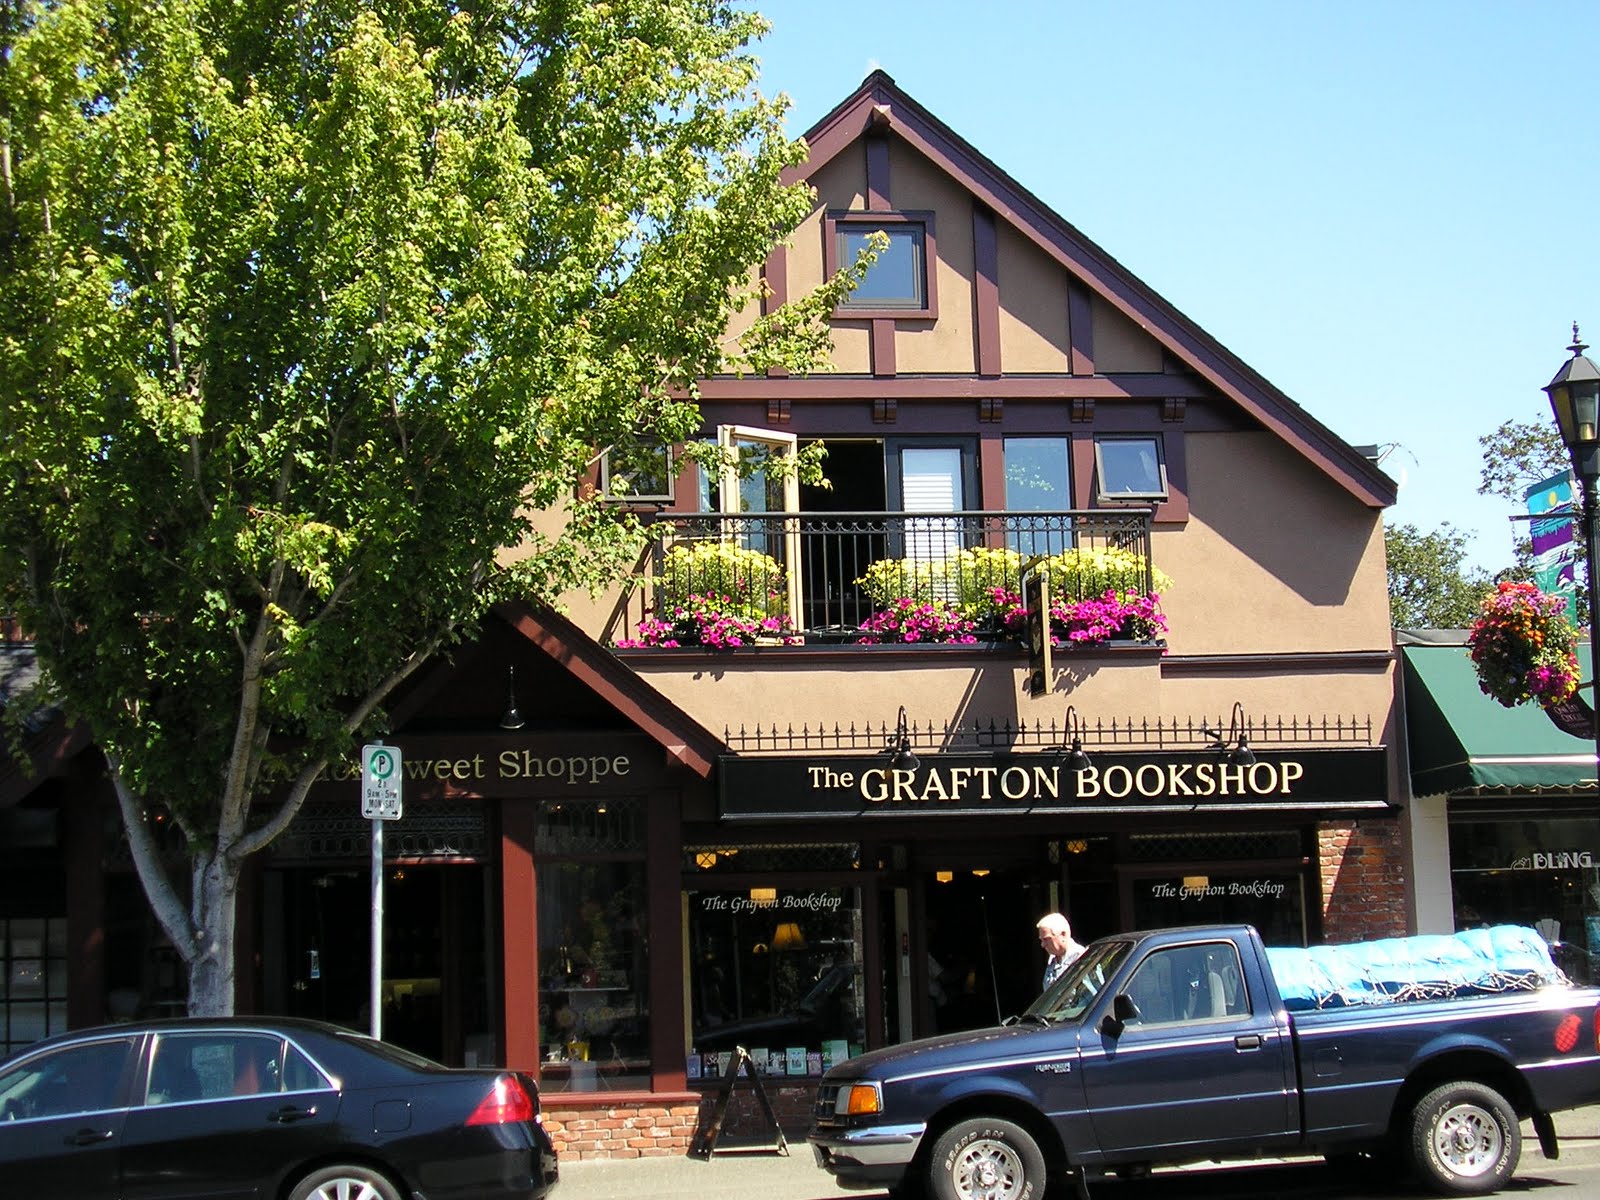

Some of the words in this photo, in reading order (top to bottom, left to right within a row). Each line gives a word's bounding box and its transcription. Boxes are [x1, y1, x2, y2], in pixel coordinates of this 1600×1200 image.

[378, 755, 386, 773] P
[403, 753, 485, 780] weet
[499, 749, 630, 785] Shoppe
[807, 766, 854, 788] The
[860, 765, 1060, 802] GRAFTON
[1076, 761, 1304, 798] BOOKSHOP
[1152, 883, 1176, 898] The
[1179, 882, 1226, 902] Grafton
[1228, 880, 1285, 899] Bookshop
[702, 896, 728, 911] The
[782, 892, 842, 913] Bookshop
